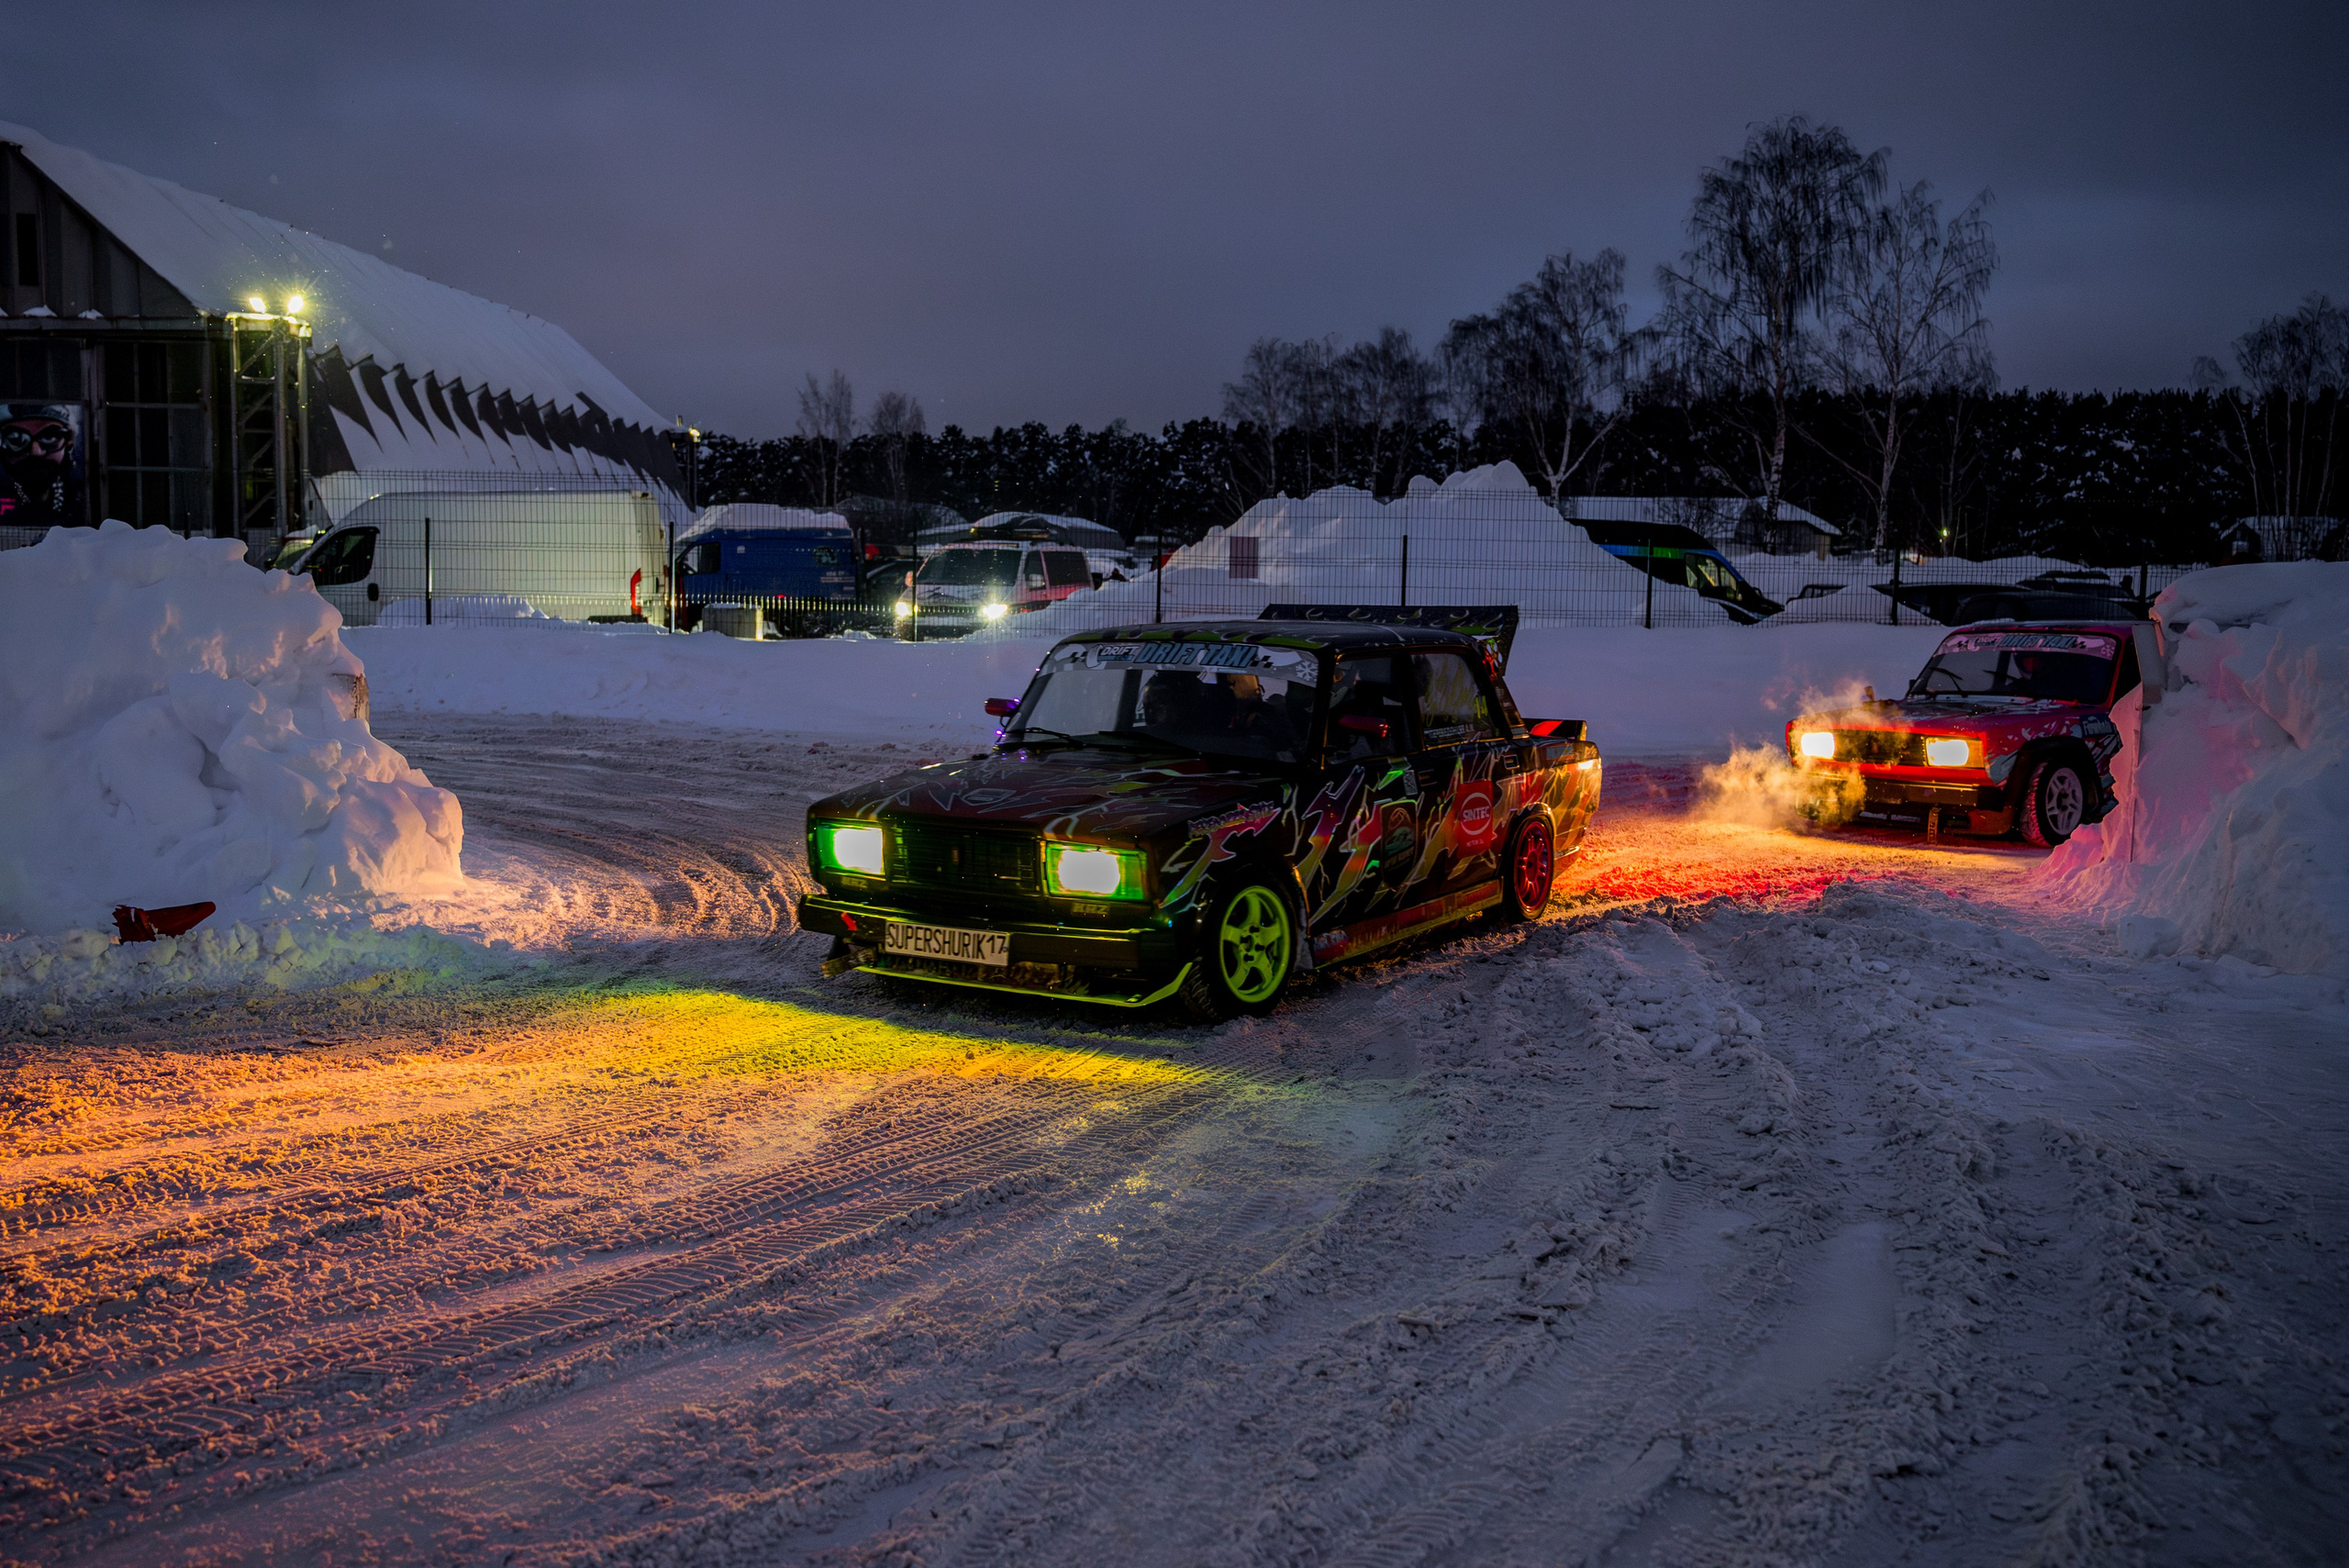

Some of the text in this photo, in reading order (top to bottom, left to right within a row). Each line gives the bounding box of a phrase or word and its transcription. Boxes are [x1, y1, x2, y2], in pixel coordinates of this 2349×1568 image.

[1100, 645, 1140, 655] DRIFT
[1999, 634, 2077, 649] DRIFT TAXI
[1133, 642, 1259, 668] DRIFT TAXI
[1462, 805, 1490, 822] SINTEC
[886, 923, 1008, 960] SUPERSHURIK17
